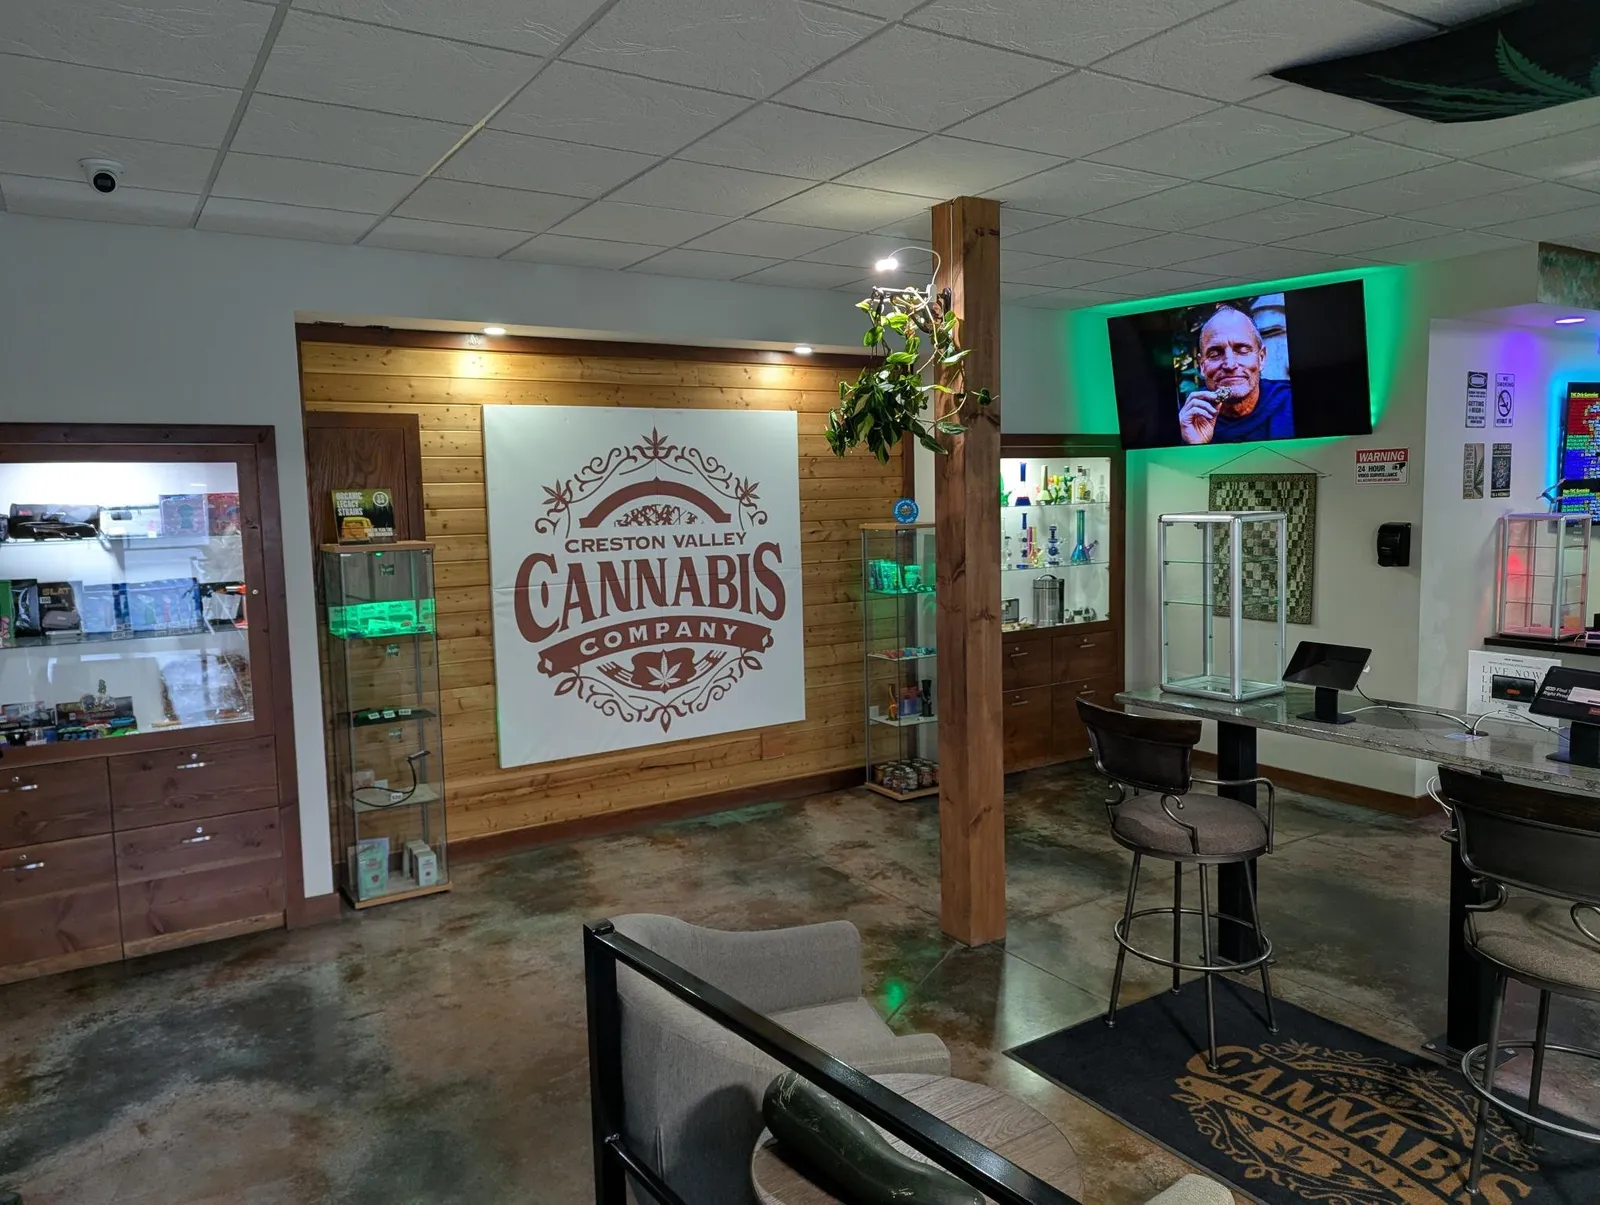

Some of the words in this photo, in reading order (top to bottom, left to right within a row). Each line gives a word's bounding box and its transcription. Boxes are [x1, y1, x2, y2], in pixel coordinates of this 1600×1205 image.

[1359, 450, 1405, 463] WARNING
[1368, 464, 1386, 472] HOUR
[336, 500, 359, 508] LEGACY
[338, 507, 364, 516] STRAINS
[565, 534, 666, 554] CRESTON
[672, 531, 747, 549] VALLEY
[513, 541, 786, 643] CANNABIS
[579, 621, 738, 656] COMPANY
[1482, 665, 1509, 676] LIVE
[1515, 669, 1543, 680] NOW
[1223, 1094, 1417, 1190] COMPANY
